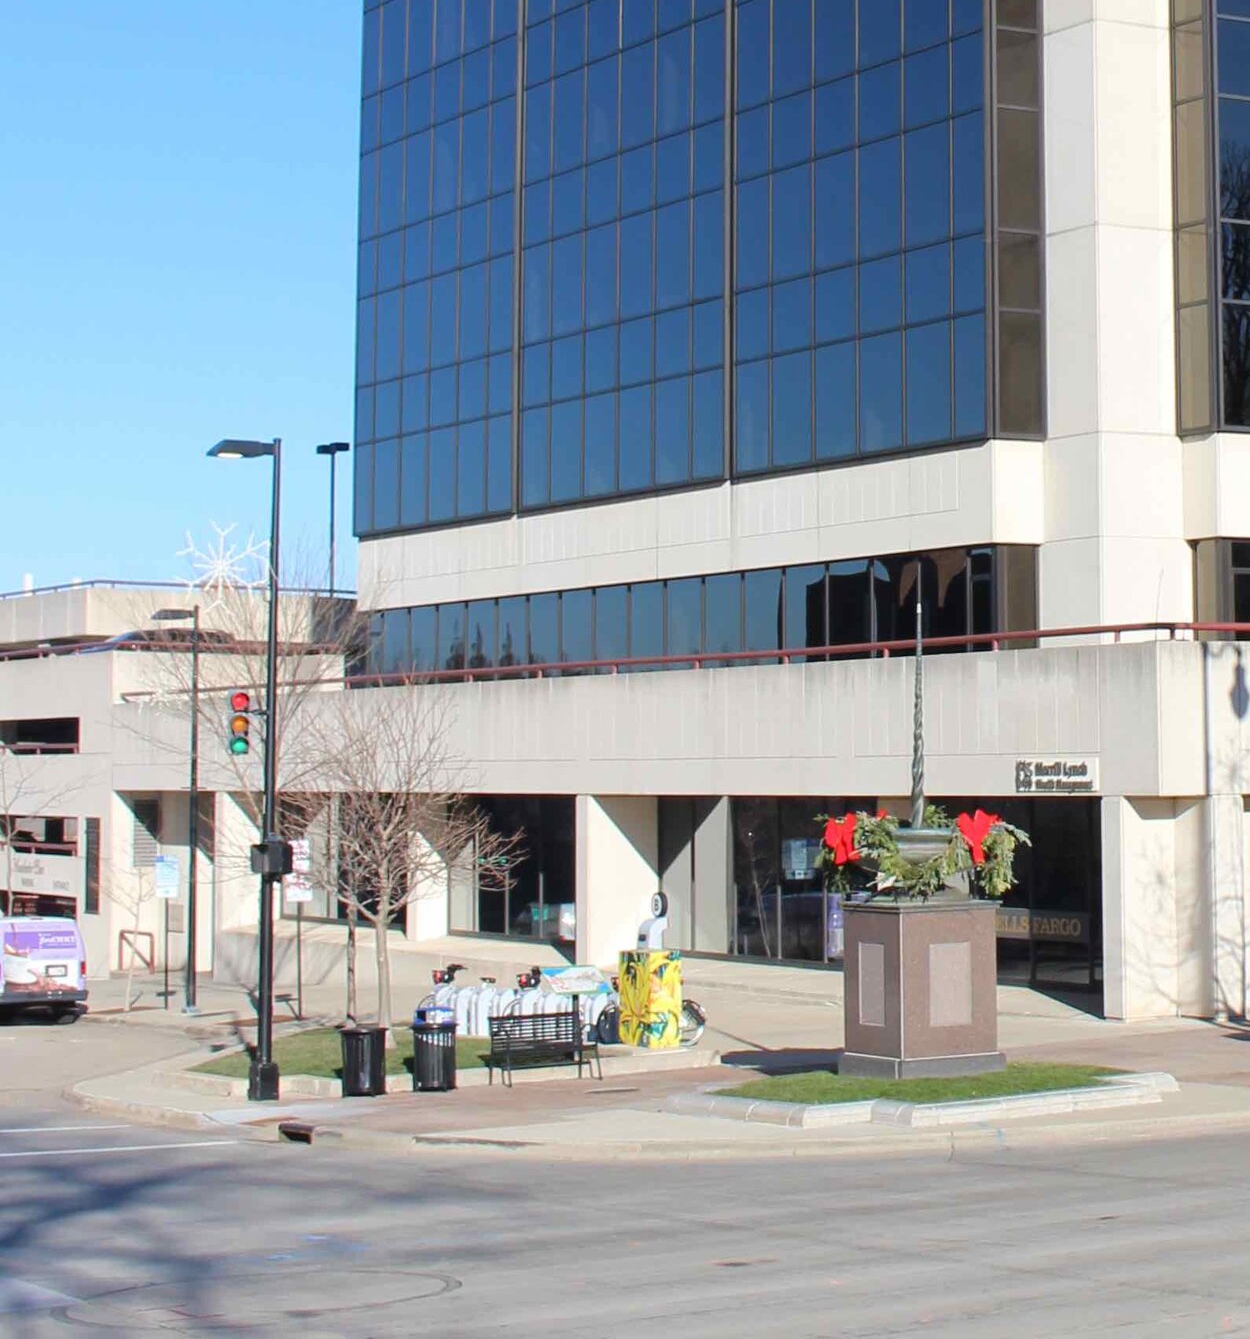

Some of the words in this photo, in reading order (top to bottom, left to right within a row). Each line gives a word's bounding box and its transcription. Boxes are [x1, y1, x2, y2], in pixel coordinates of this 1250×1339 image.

[1034, 761, 1061, 777] Merrill
[1062, 761, 1087, 779] Lynch
[994, 914, 1030, 935] ELLS
[1033, 917, 1081, 936] FARGO
